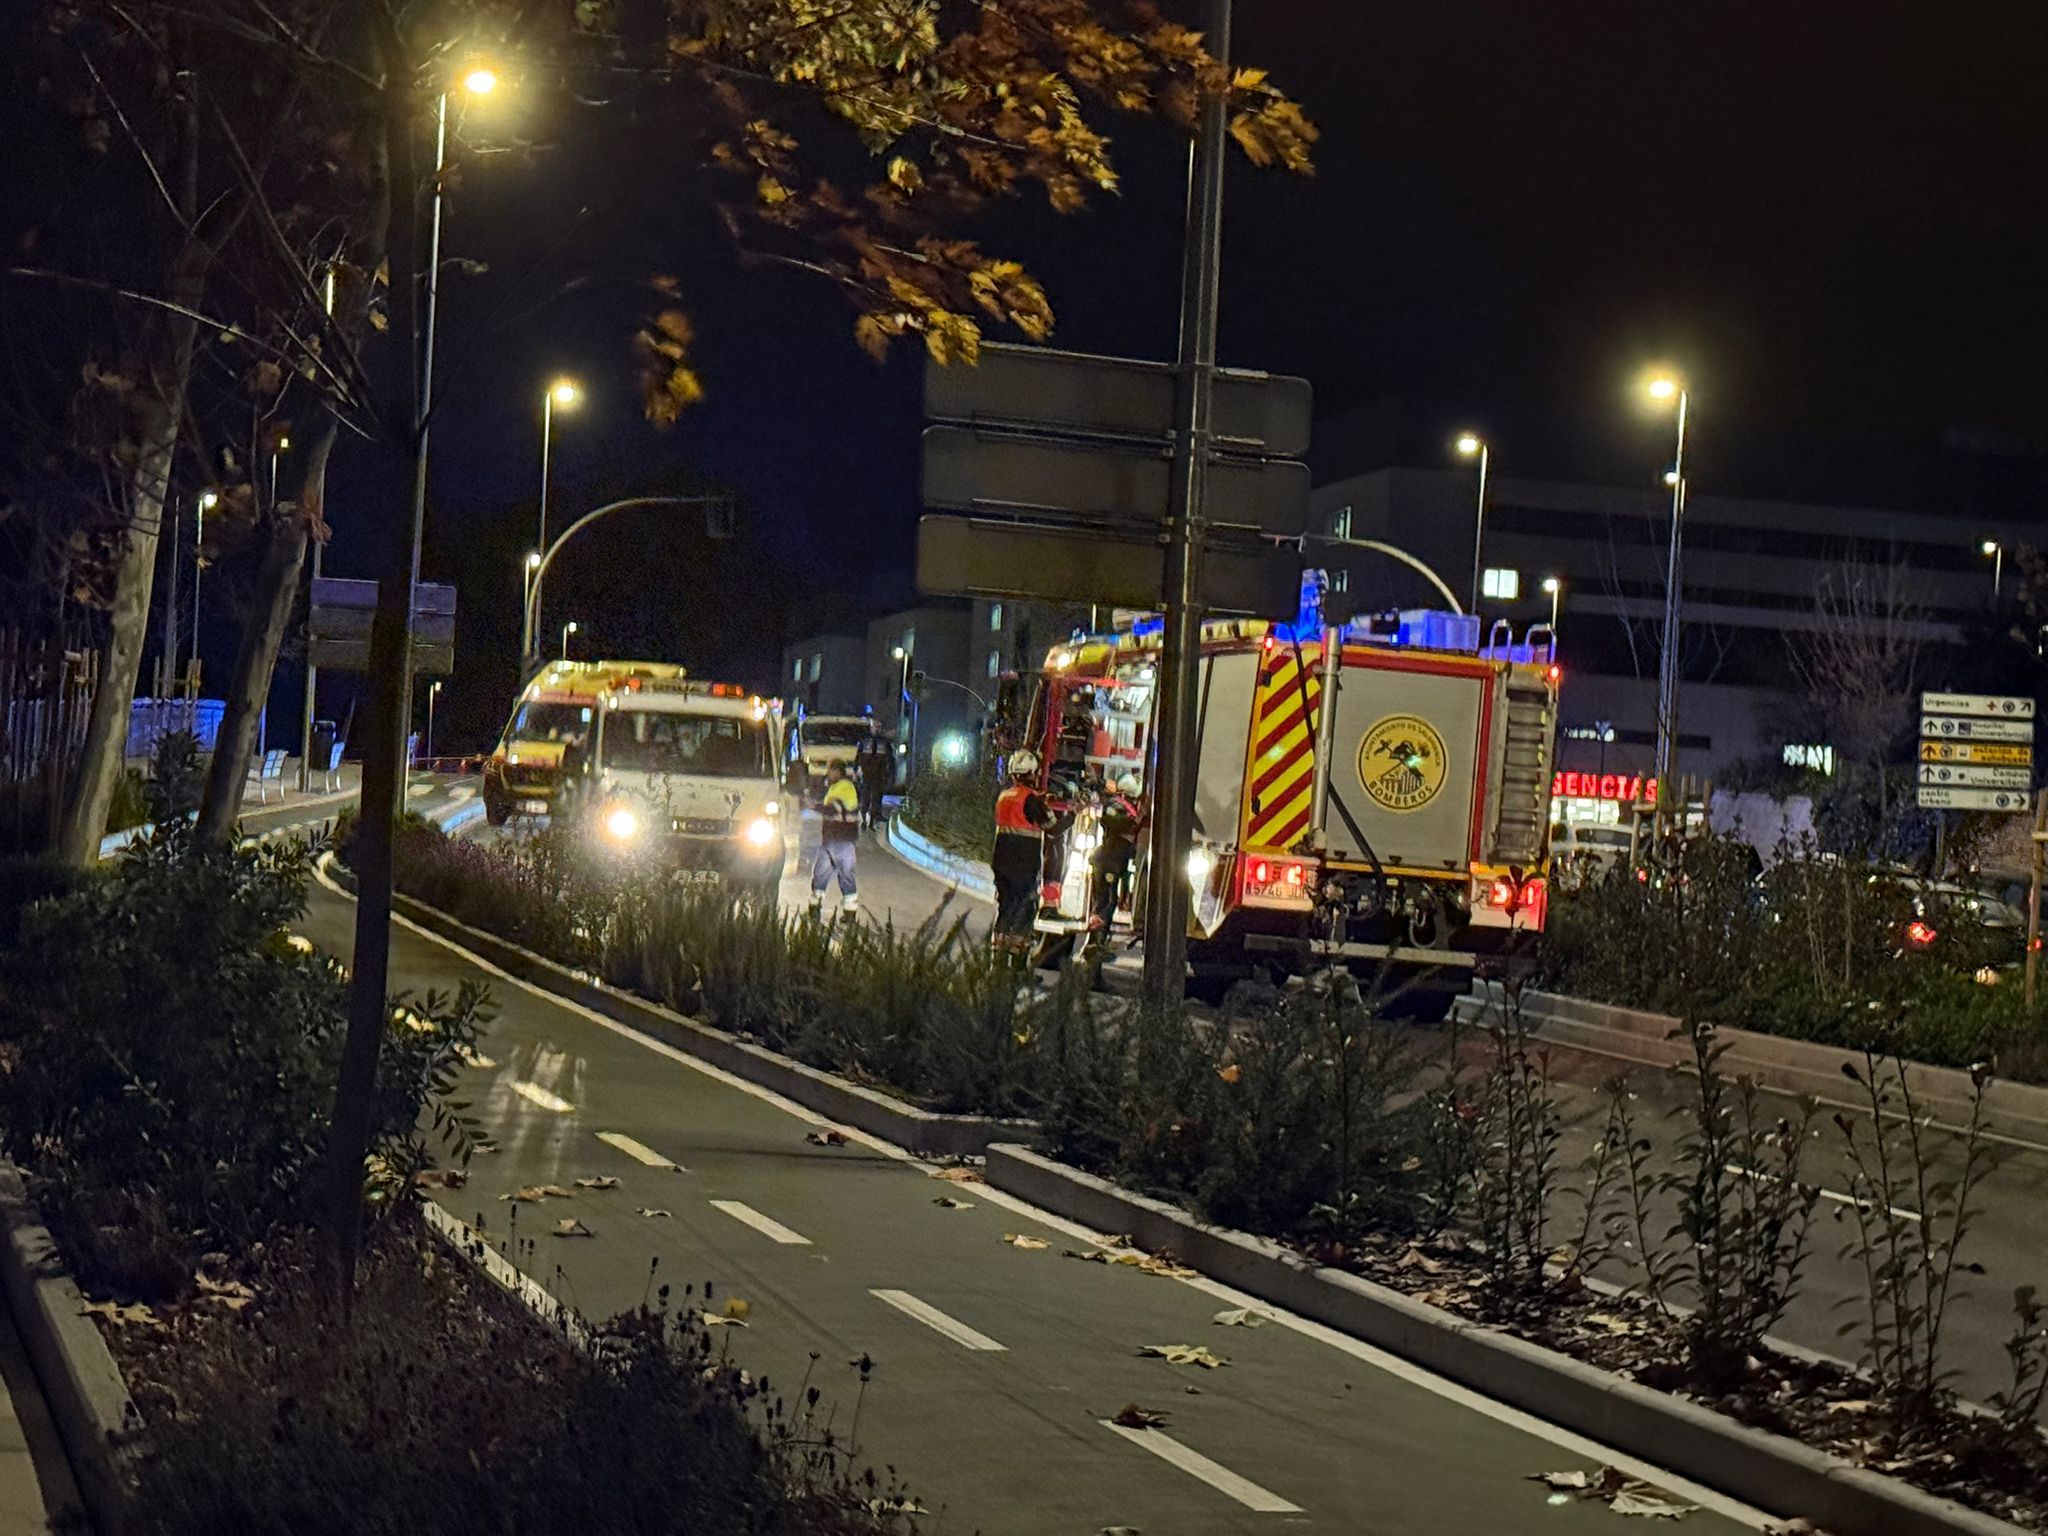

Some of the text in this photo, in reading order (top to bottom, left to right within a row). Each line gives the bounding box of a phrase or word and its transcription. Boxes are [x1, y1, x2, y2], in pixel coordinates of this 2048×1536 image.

[1924, 698, 1970, 709] Urgencias
[1992, 769, 2029, 778] Campus
[1970, 777, 2029, 786] Universitario
[1369, 780, 1433, 806] BOMBEROS
